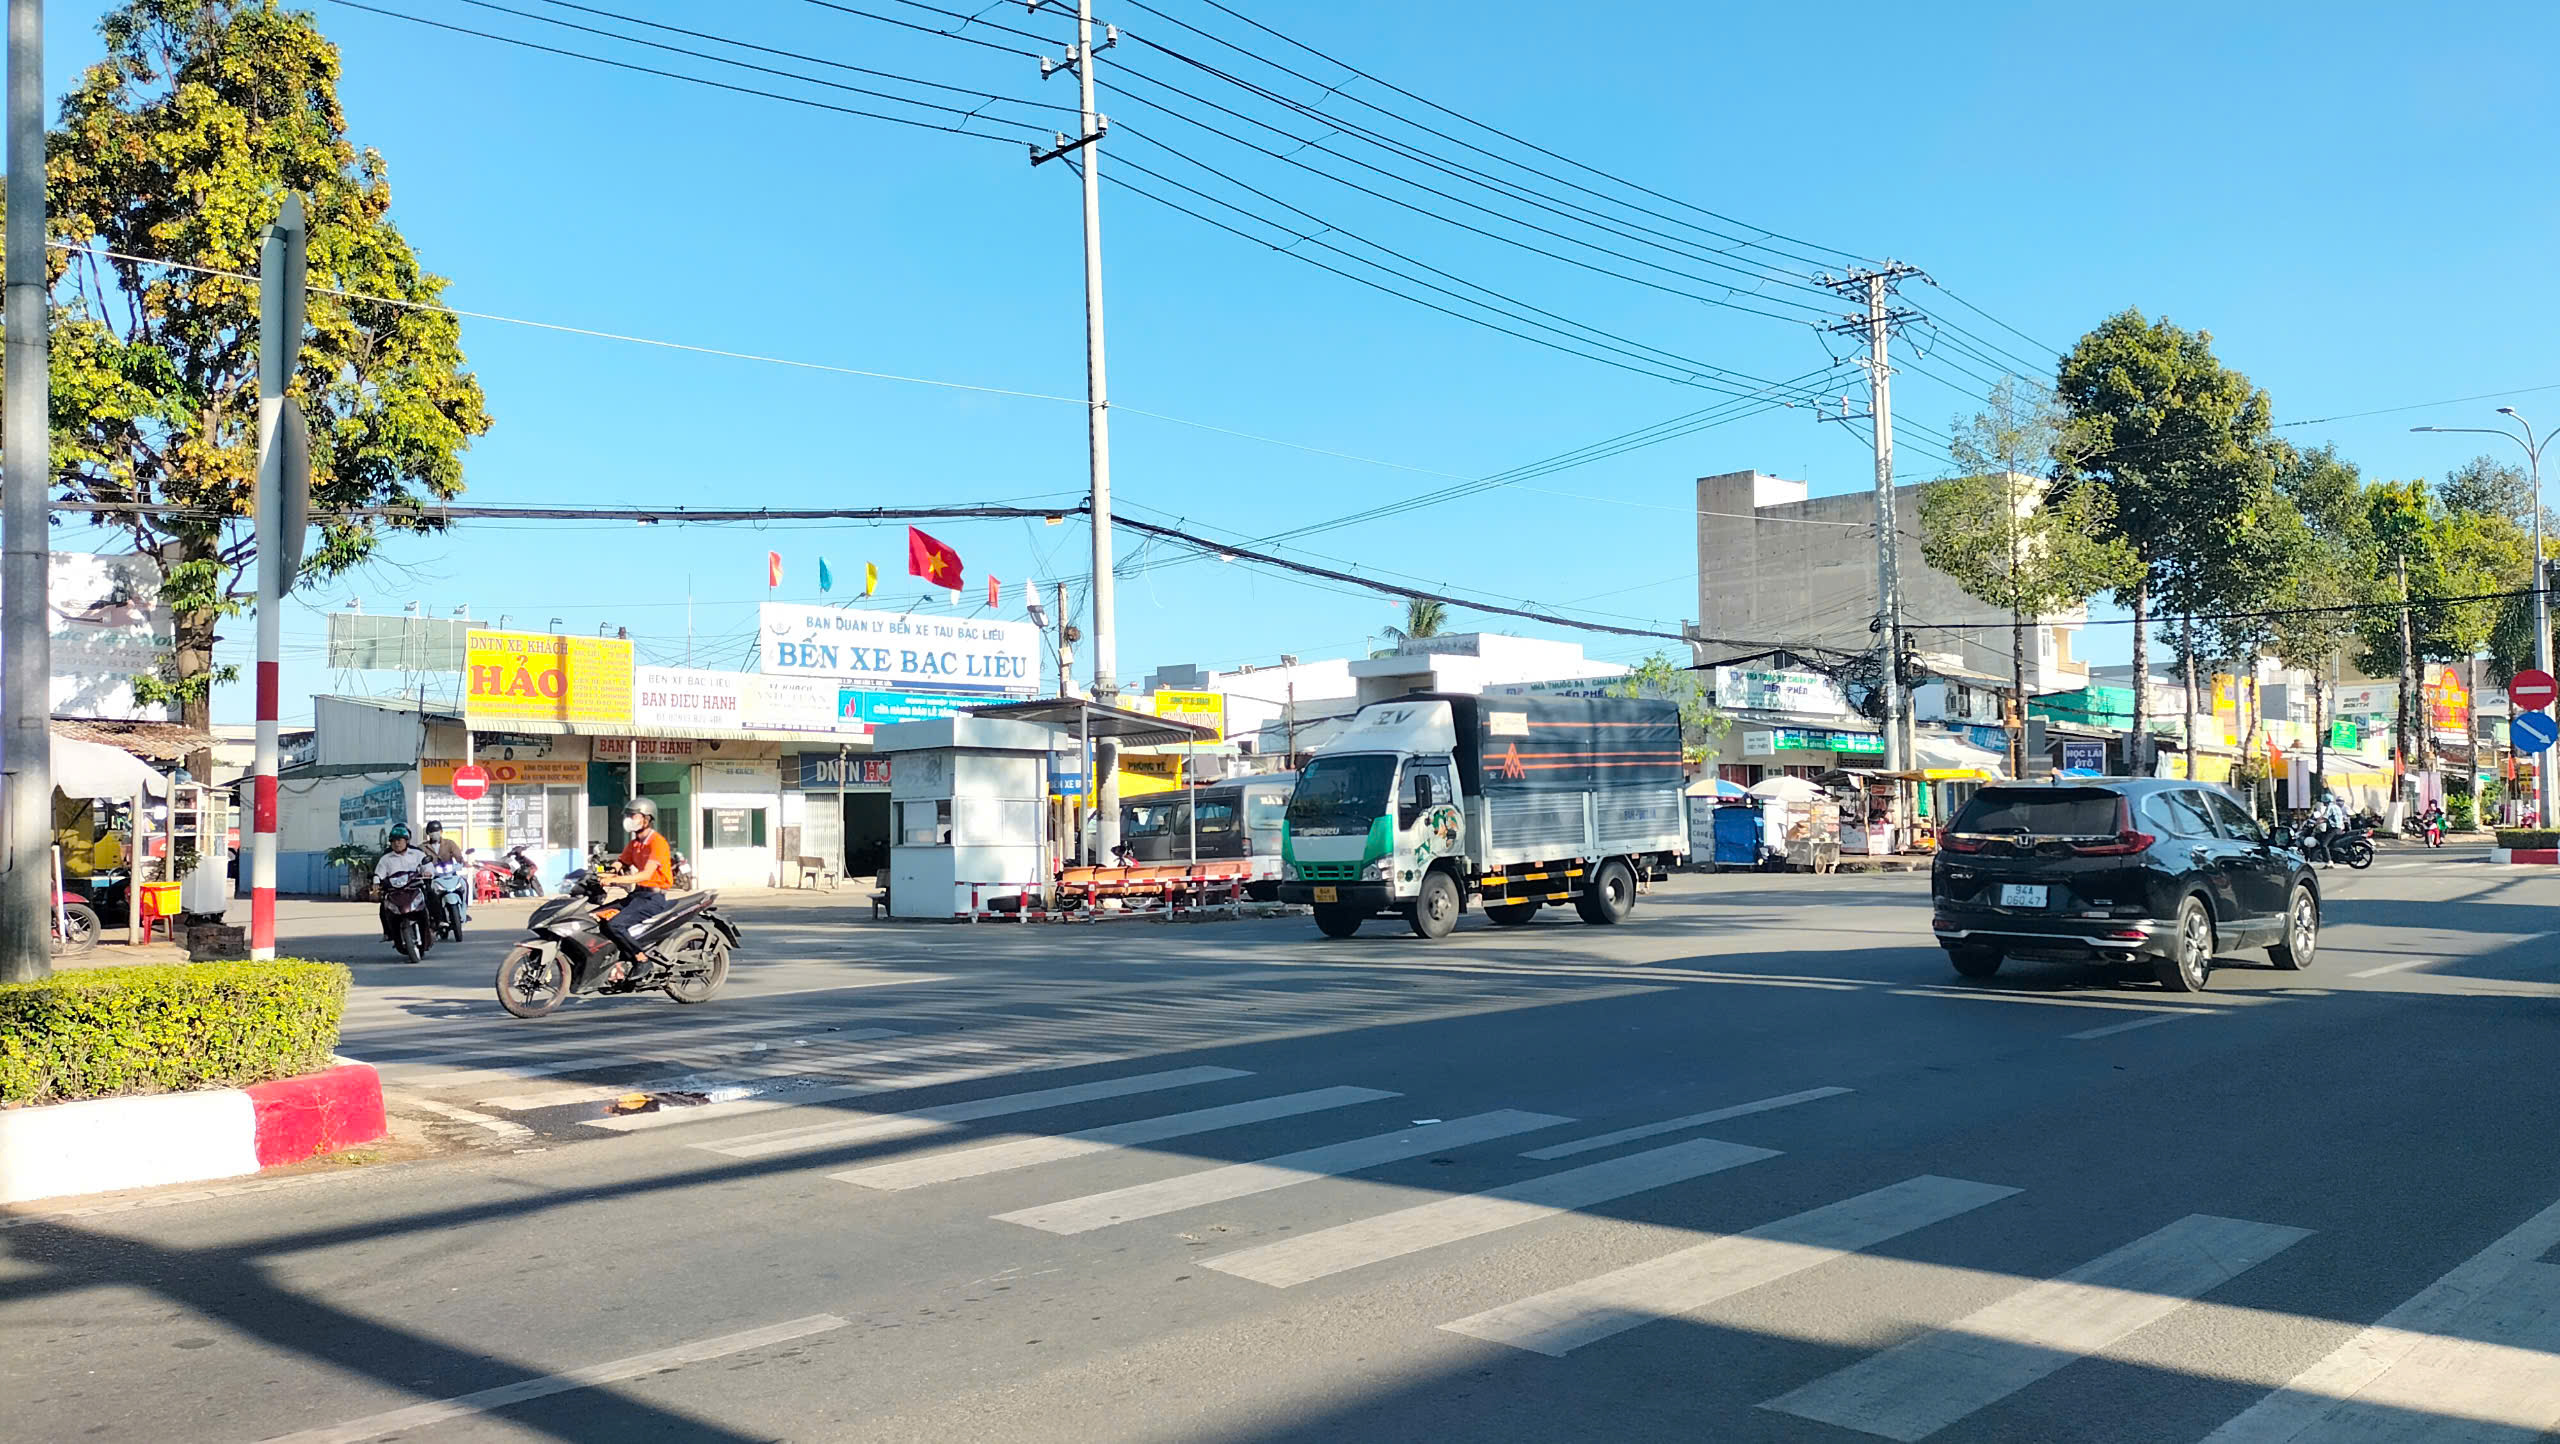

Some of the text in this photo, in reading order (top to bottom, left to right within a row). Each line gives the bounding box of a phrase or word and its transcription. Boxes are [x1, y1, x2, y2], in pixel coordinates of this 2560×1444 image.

[915, 624, 929, 636] XE
[470, 637, 569, 655] DNTN XE KHÁCH
[778, 632, 1027, 679] BẾN XE BẠC LIÊU
[469, 654, 569, 699] HẢO
[600, 739, 624, 753] BAN
[2066, 748, 2103, 759] HỌC LÁI
[423, 758, 450, 768] DNTN
[816, 760, 860, 782] DNTN
[2015, 885, 2034, 895] 94A
